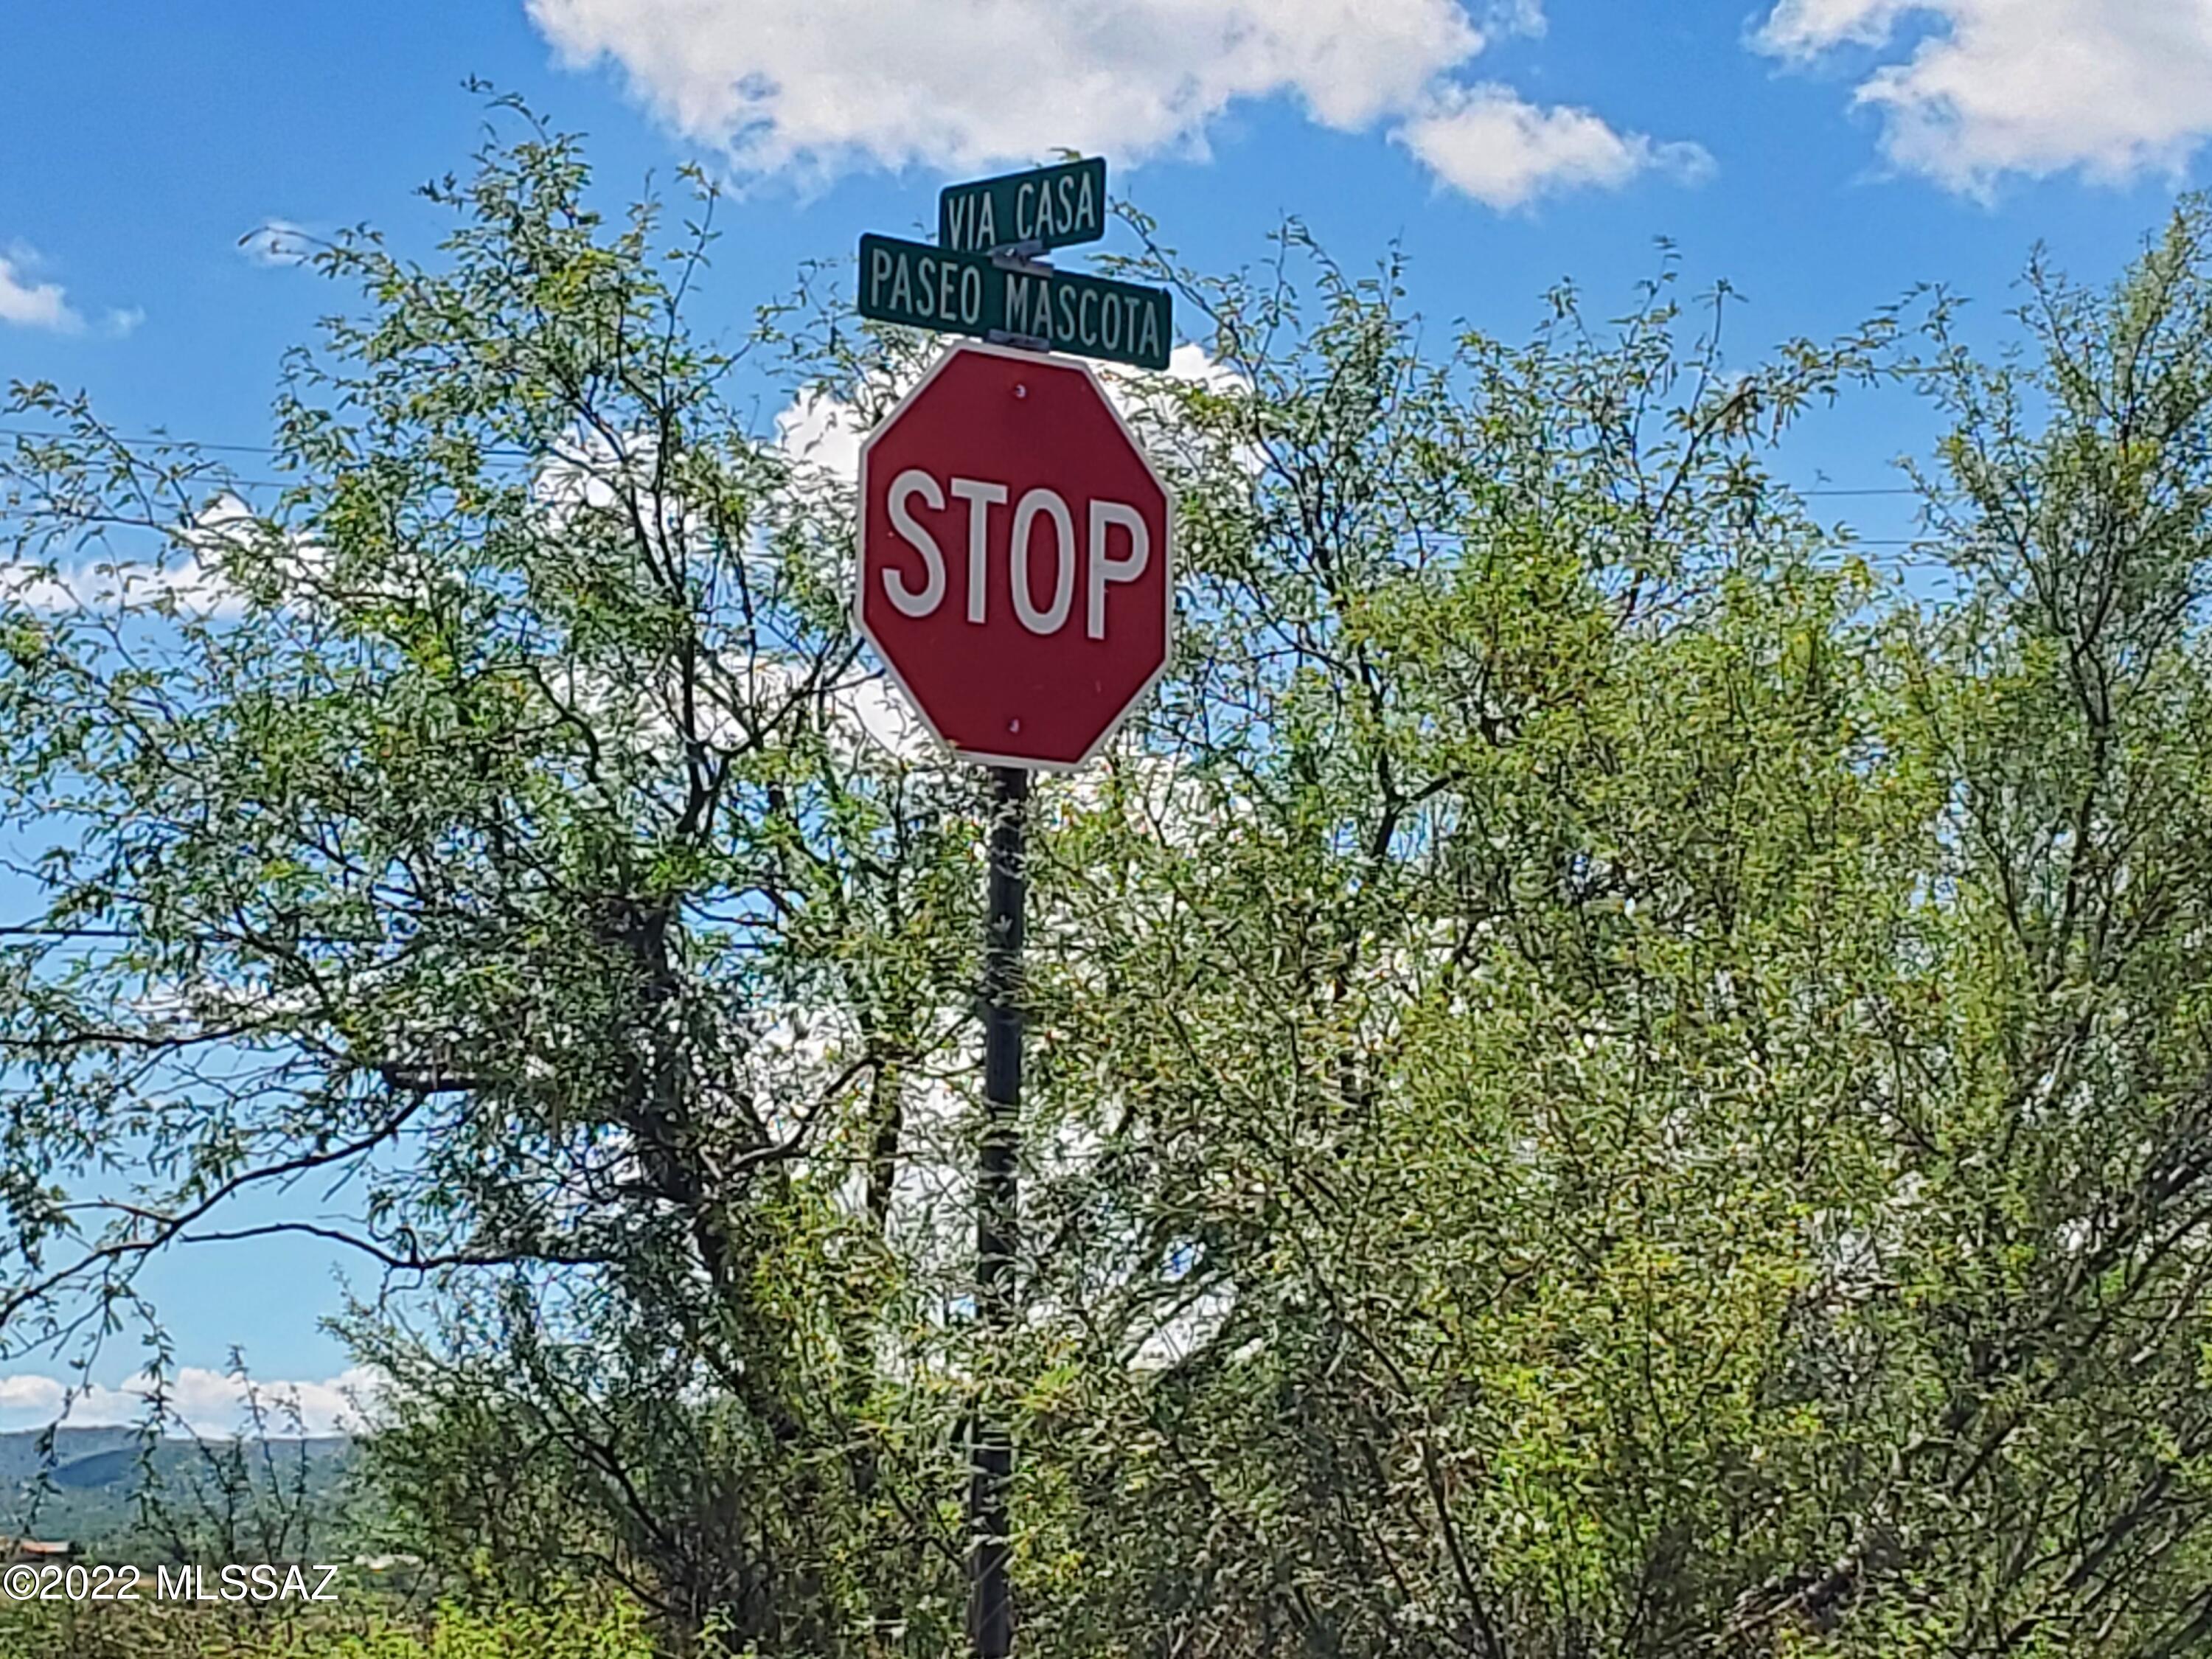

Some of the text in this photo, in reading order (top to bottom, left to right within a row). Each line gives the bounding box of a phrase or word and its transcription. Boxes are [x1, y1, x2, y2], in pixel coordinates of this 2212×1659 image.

[948, 170, 1095, 251] VIA CASA
[870, 248, 1161, 358] PASEO MASCOTA
[882, 469, 1150, 640] STOP
